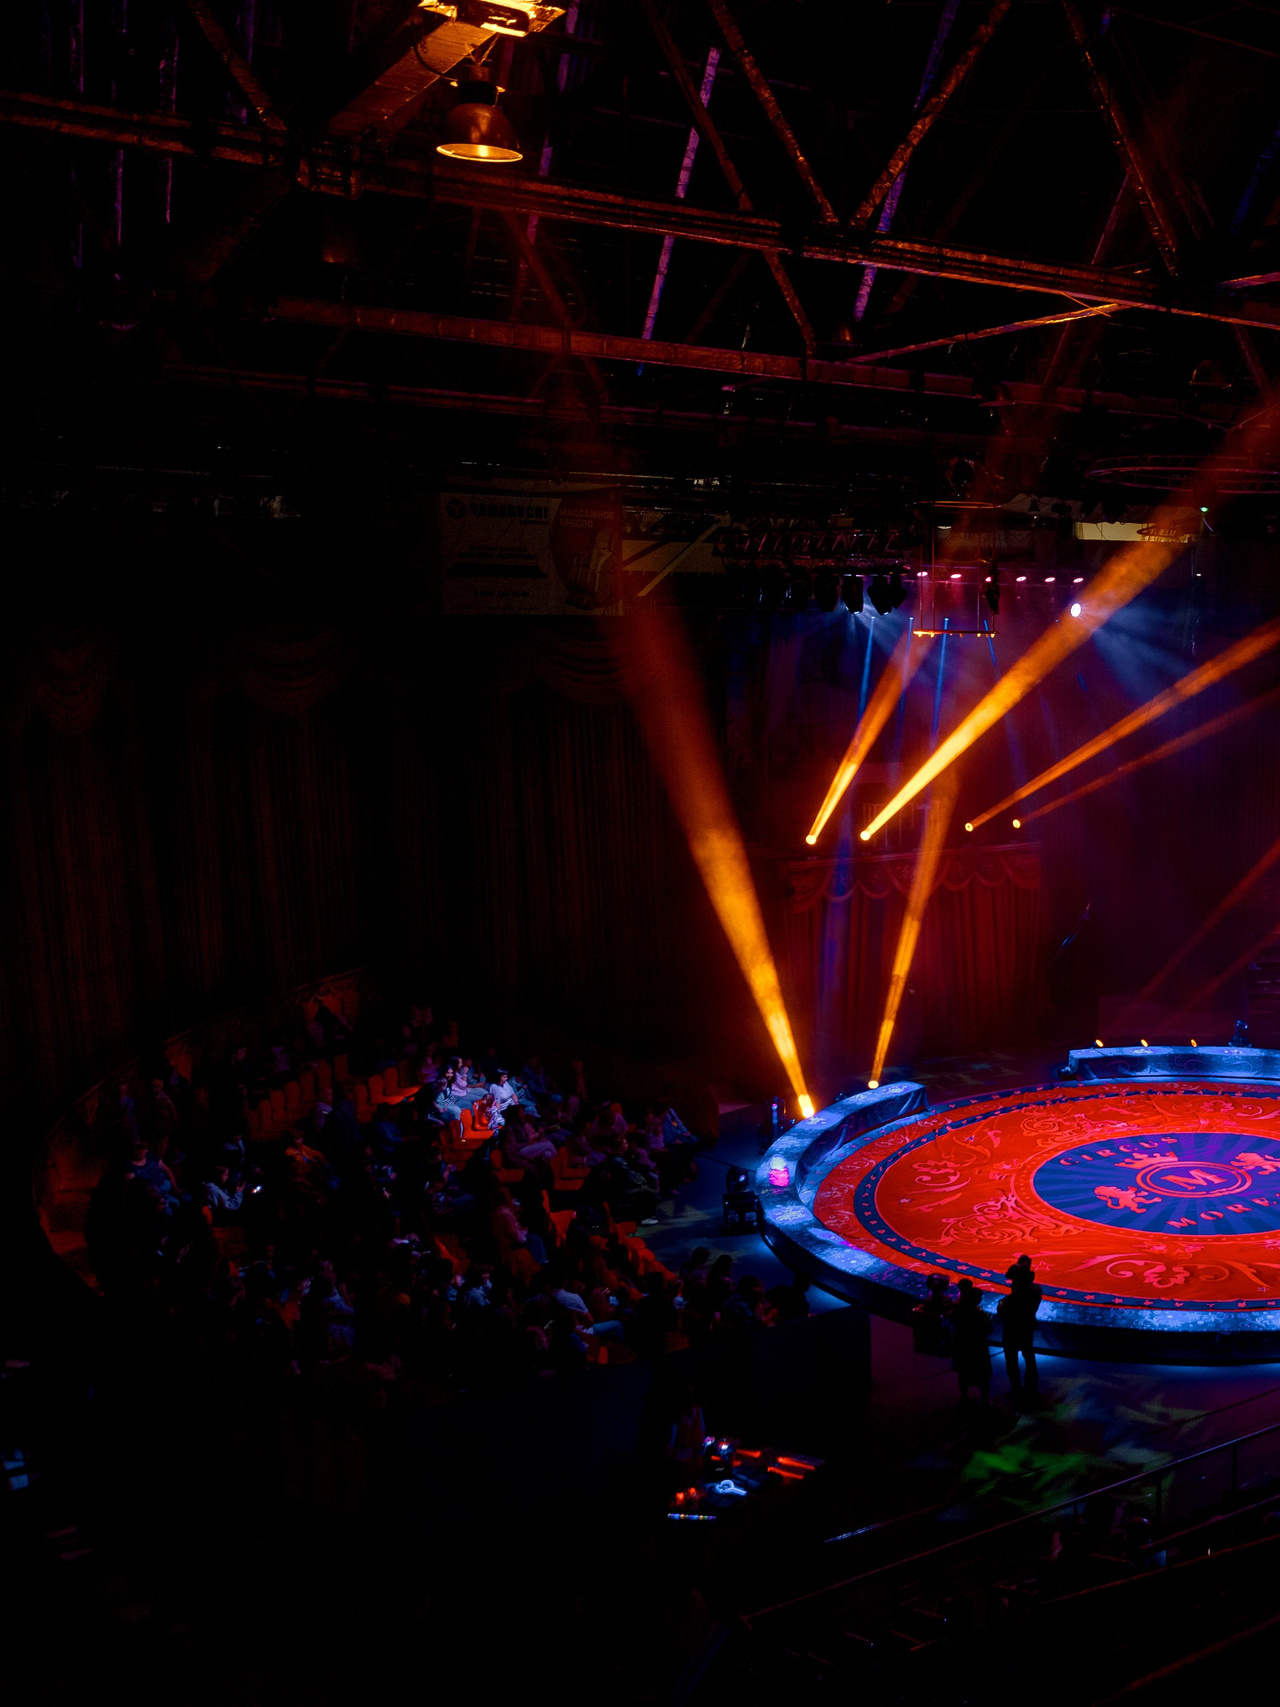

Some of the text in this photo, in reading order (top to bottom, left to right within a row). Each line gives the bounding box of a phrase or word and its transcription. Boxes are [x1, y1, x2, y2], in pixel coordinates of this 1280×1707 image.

[470, 503, 548, 519] YAMAGUCHI
[559, 508, 615, 520] МАССАЖНОЕ
[559, 518, 594, 529] КРЕСЛО
[1059, 1136, 1178, 1166] CIRCUS
[1160, 1169, 1227, 1191] M
